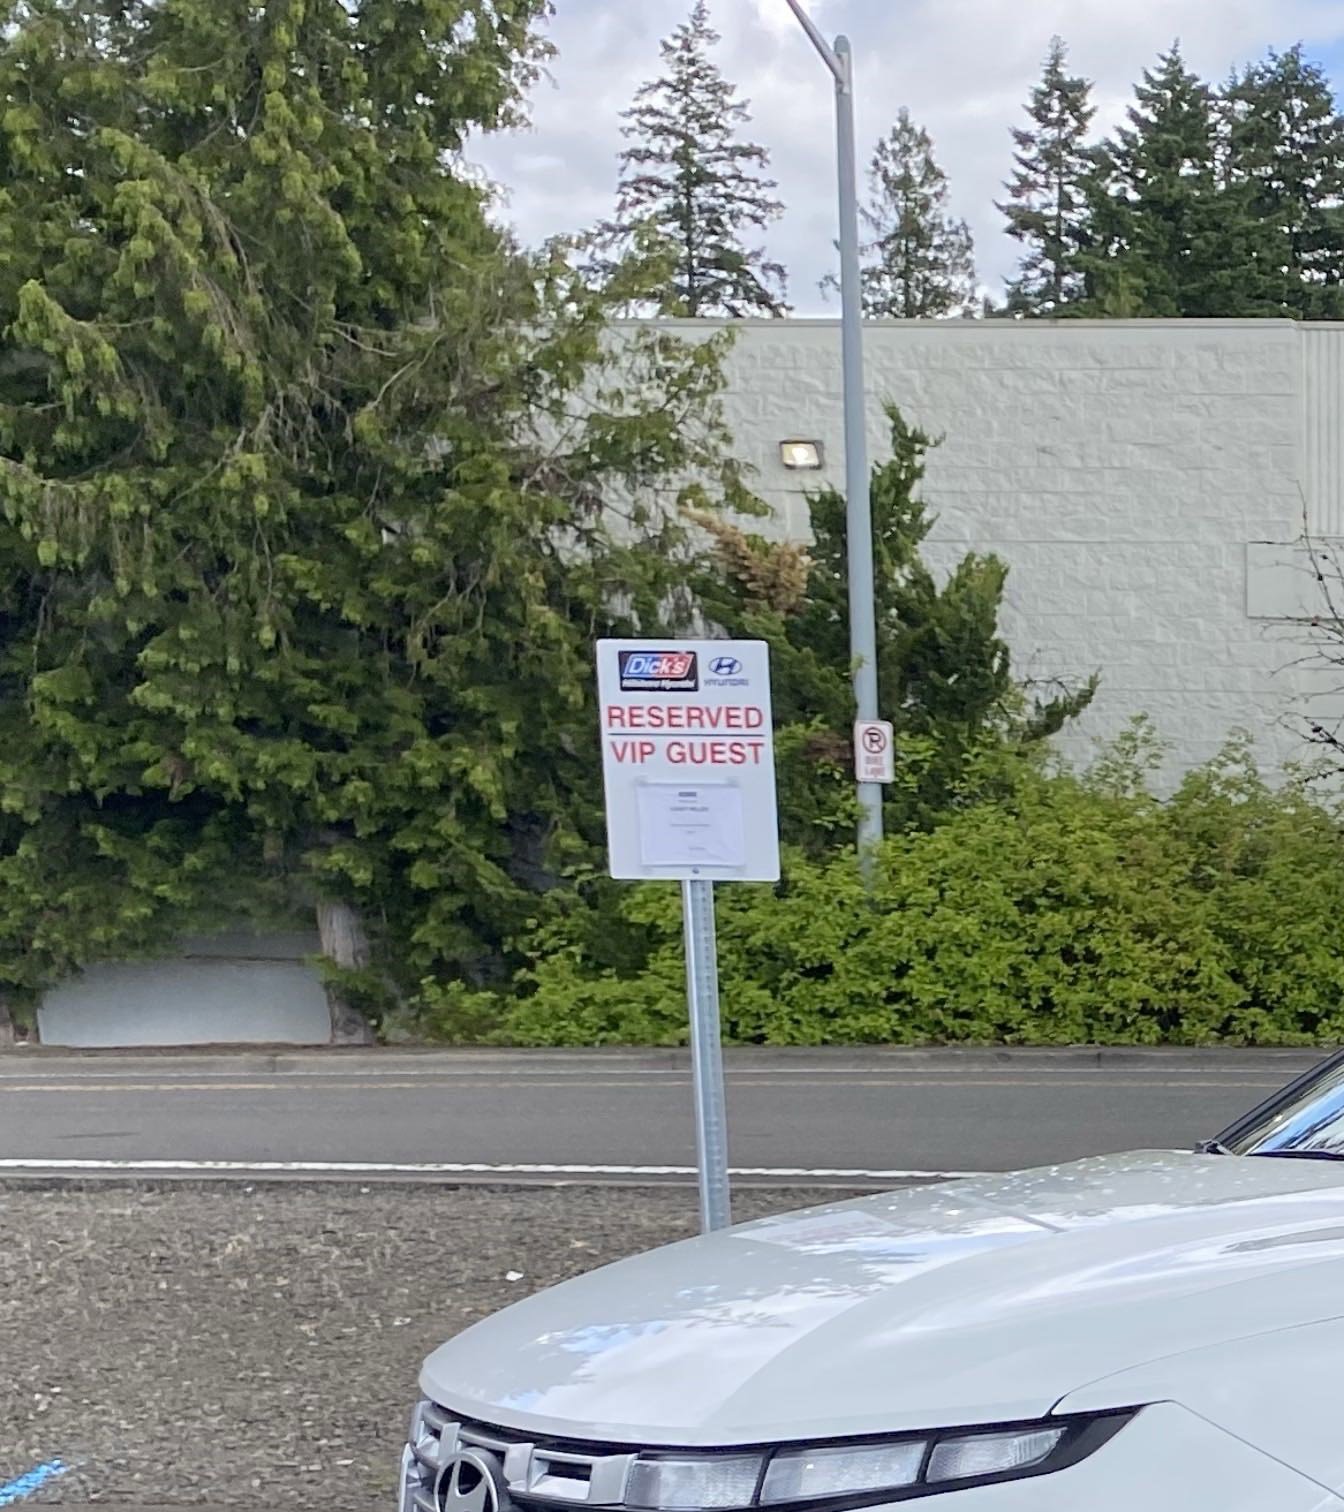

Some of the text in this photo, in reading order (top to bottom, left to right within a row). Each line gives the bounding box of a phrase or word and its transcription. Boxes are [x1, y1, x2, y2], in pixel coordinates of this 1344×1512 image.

[628, 656, 687, 674] Dick's
[607, 704, 764, 729] RESERVED
[611, 740, 764, 766] VIP GUEST
